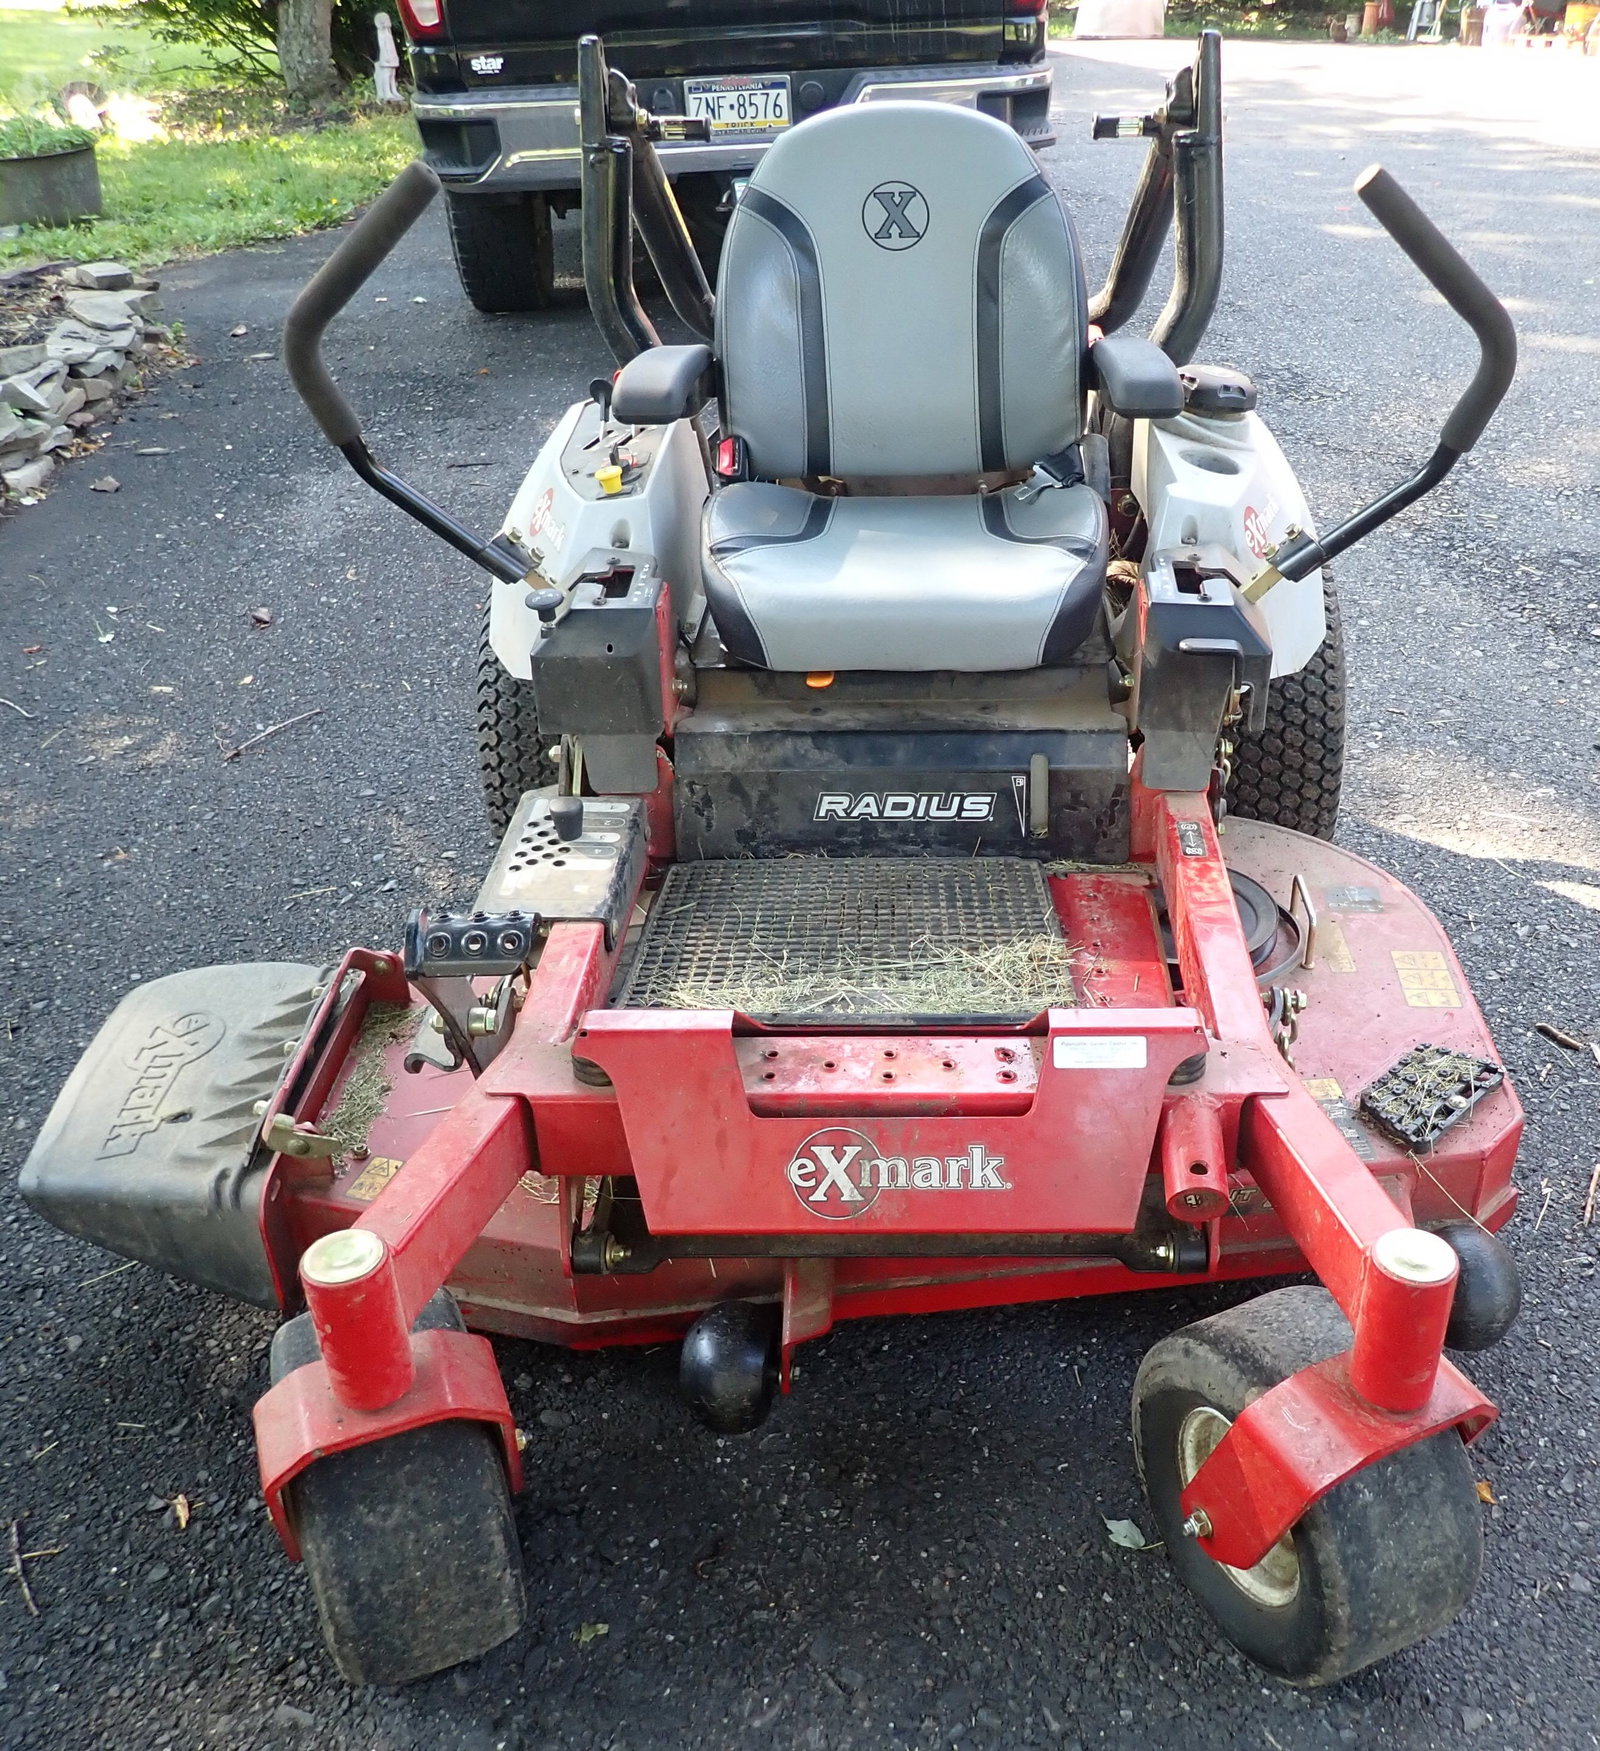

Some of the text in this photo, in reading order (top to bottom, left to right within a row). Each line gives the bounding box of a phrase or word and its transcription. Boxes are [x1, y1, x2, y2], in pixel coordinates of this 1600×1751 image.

[471, 56, 504, 70] star
[873, 191, 921, 239] X
[815, 793, 995, 820] RADIUS
